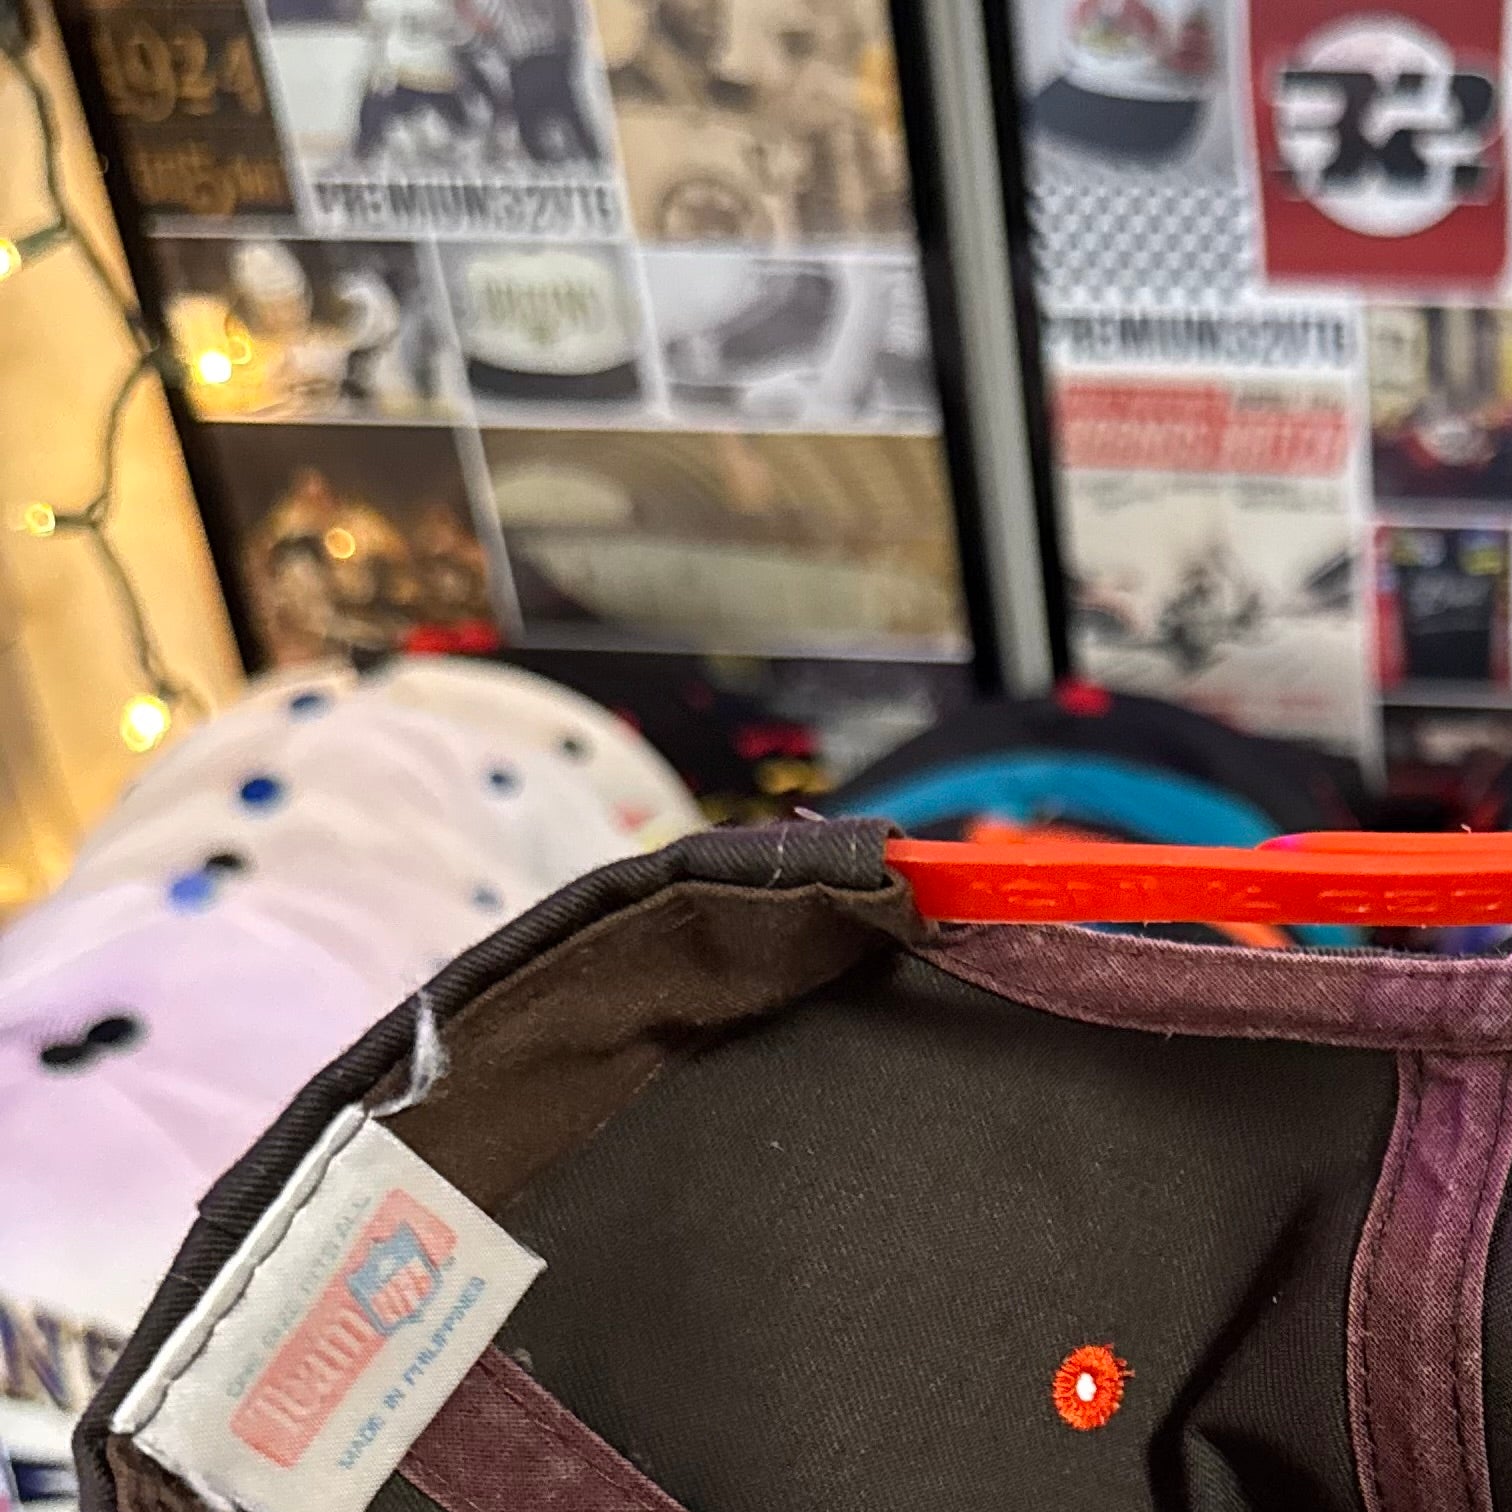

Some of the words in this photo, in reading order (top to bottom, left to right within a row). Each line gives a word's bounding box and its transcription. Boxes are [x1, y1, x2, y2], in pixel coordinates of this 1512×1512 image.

[244, 1302, 375, 1438] Team
[338, 1413, 384, 1470] MADE
[401, 1276, 487, 1385] PHILIPPINES
